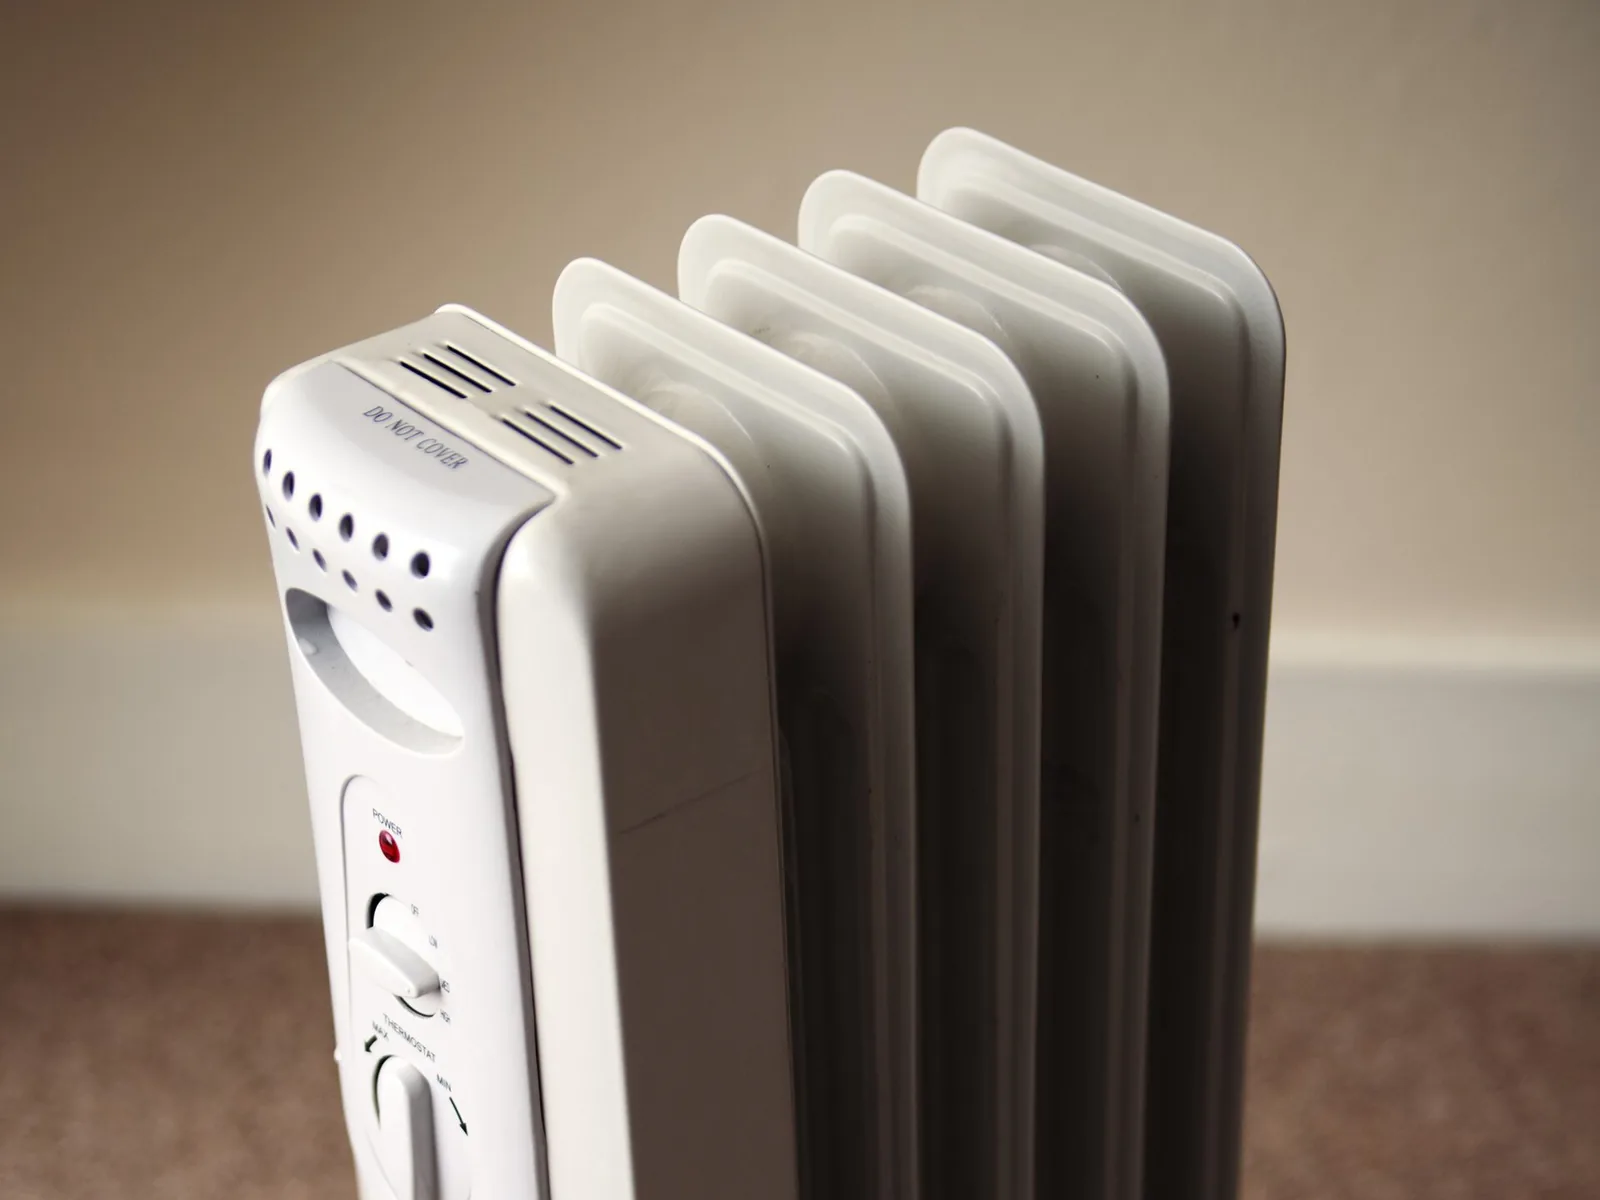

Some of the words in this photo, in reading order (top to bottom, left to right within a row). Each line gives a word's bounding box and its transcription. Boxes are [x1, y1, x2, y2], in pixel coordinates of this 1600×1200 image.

[363, 405, 393, 423] DO
[384, 419, 425, 441] NOT
[416, 438, 469, 469] COVER
[372, 807, 403, 839] POWER
[372, 1020, 389, 1041] MAX
[383, 1012, 436, 1063] THERMOSTAT
[436, 1073, 452, 1092] MIN
